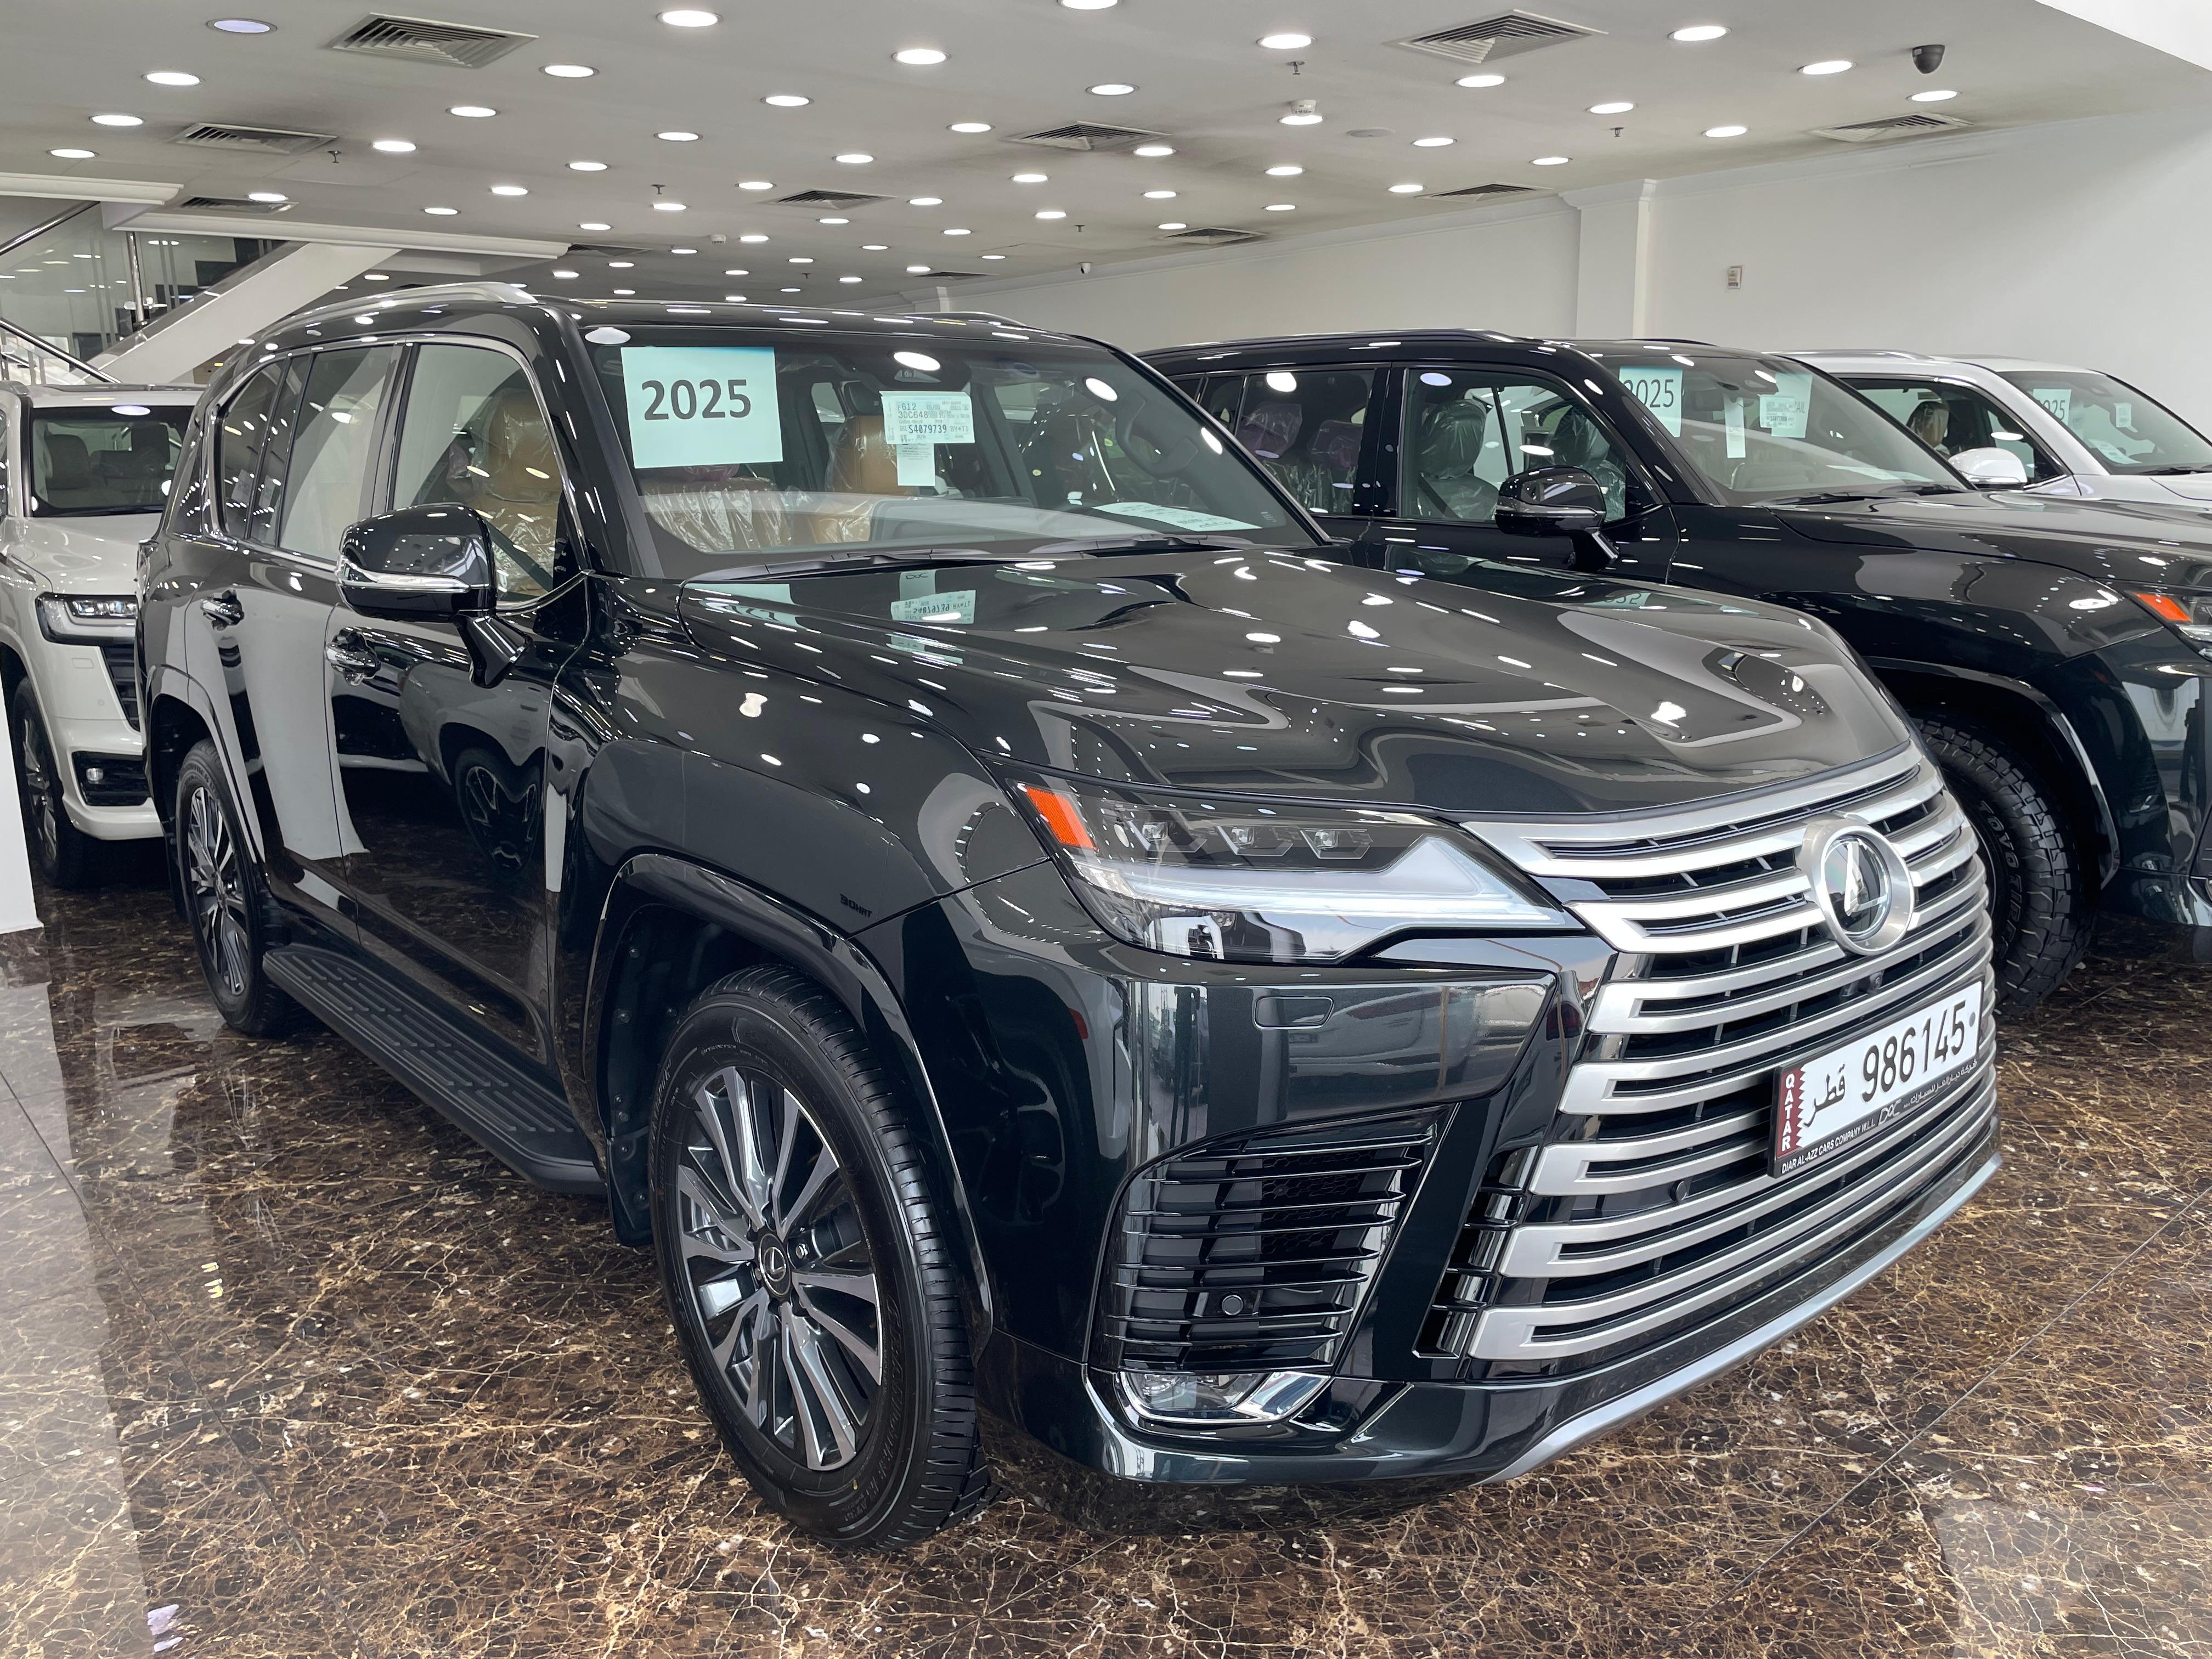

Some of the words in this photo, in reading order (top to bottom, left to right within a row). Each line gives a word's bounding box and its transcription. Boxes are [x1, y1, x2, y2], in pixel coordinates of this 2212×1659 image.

[641, 379, 752, 421] 2025
[2036, 399, 2066, 421] 025
[909, 424, 947, 434] S4079739
[1978, 799, 2019, 868] TOYO
[1861, 998, 1966, 1103] 986145
[1781, 1073, 1795, 1152] QATAR
[1802, 1063, 1846, 1128] قطر
[1781, 1158, 1797, 1174] DIAR
[1797, 1147, 1818, 1167] AL-AZZ
[1818, 1139, 1835, 1155] CARS
[1835, 1125, 1861, 1147] COMPANY
